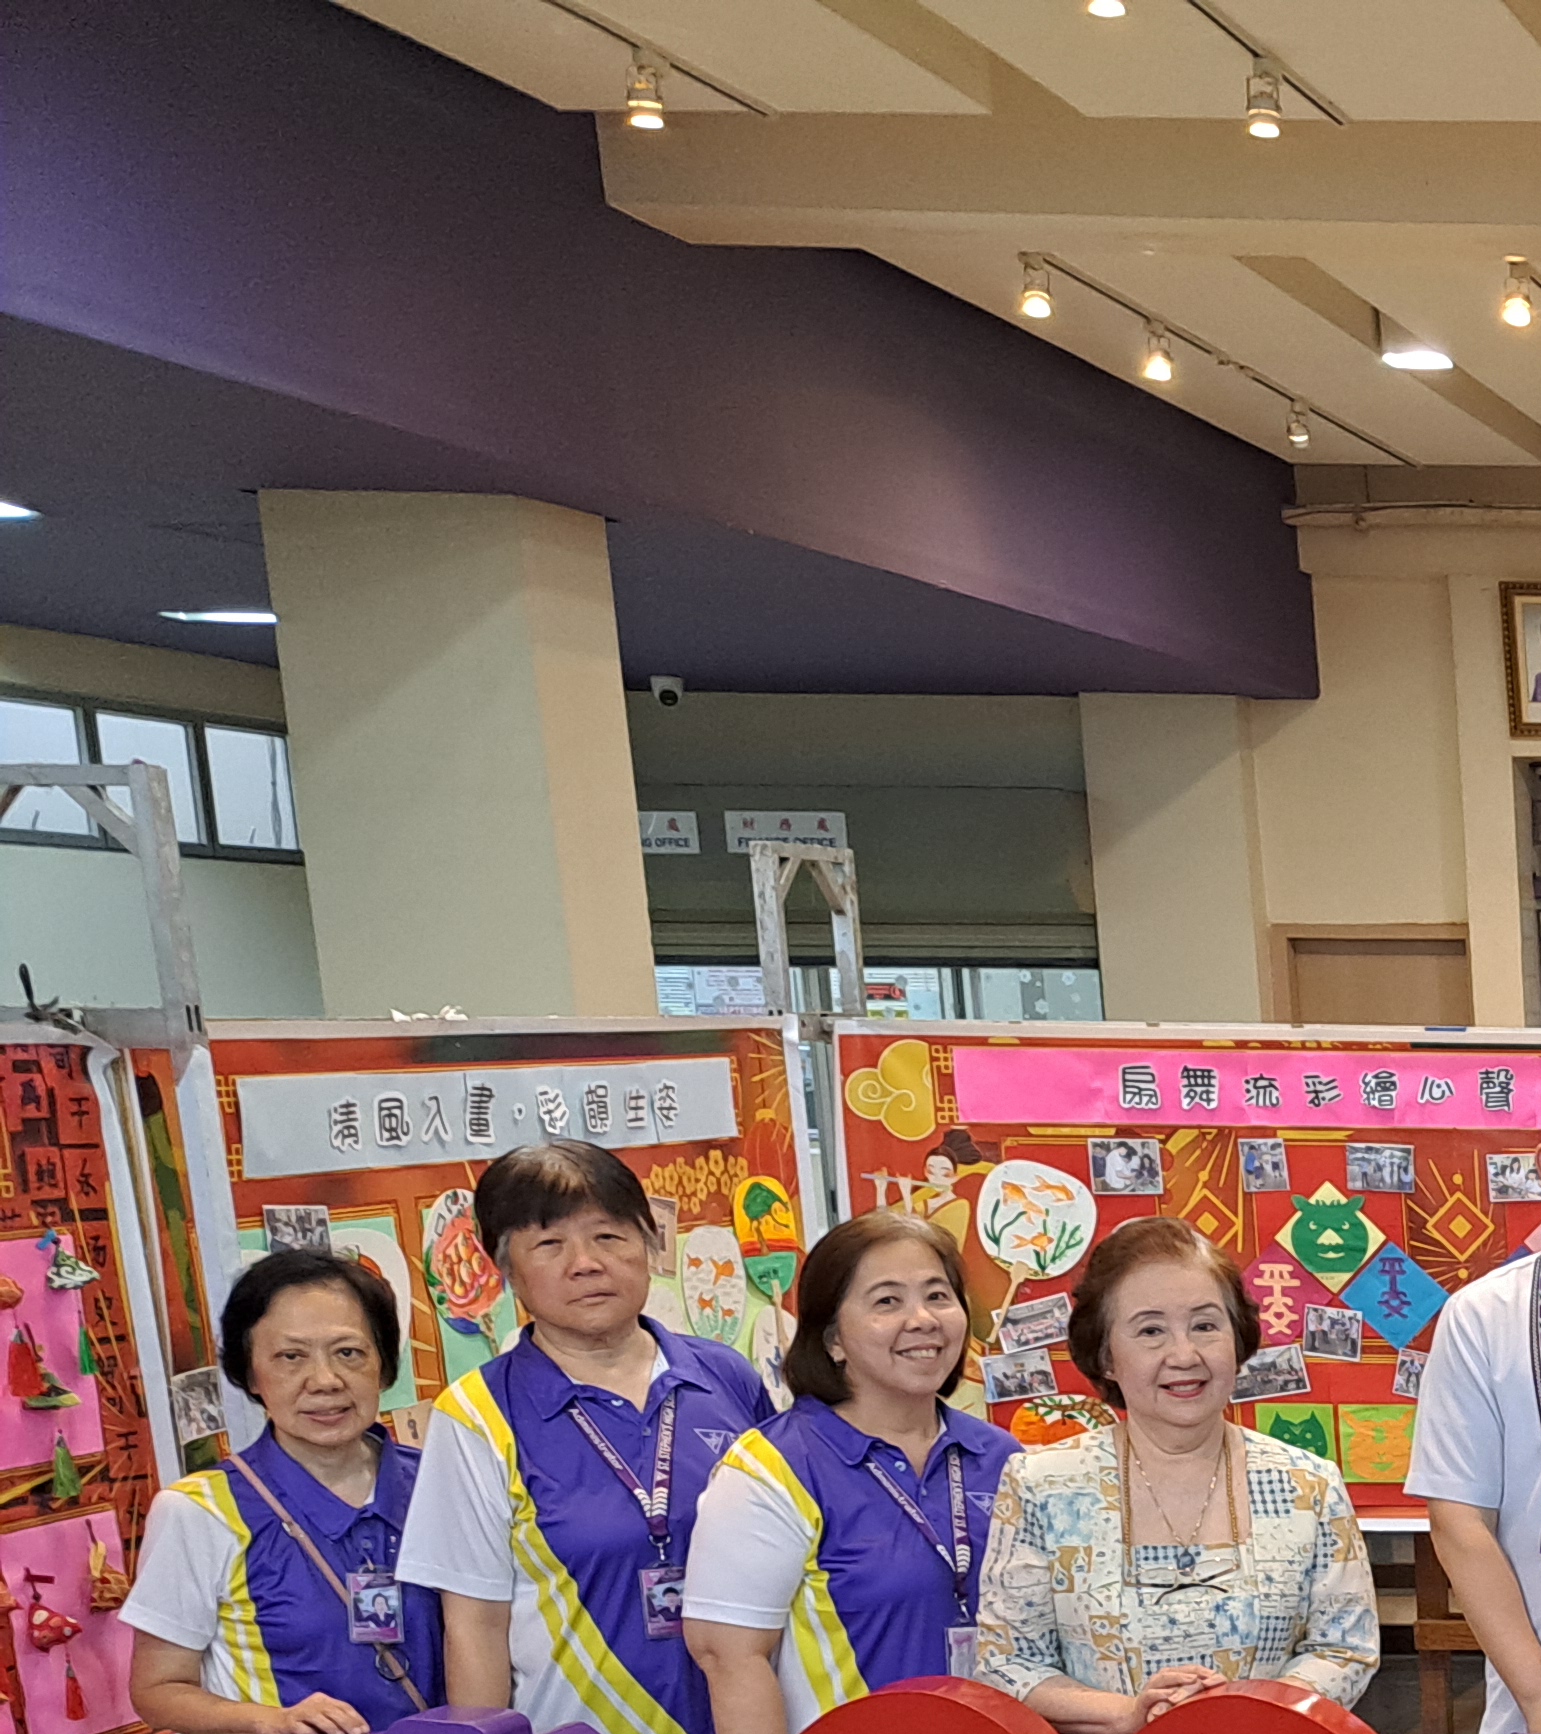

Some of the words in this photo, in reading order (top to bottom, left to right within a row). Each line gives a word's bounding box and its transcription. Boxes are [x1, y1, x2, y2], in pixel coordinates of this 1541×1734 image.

[654, 837, 690, 848] OFFICE
[1119, 1065, 1515, 1112] 扇舞流彩繪心聲
